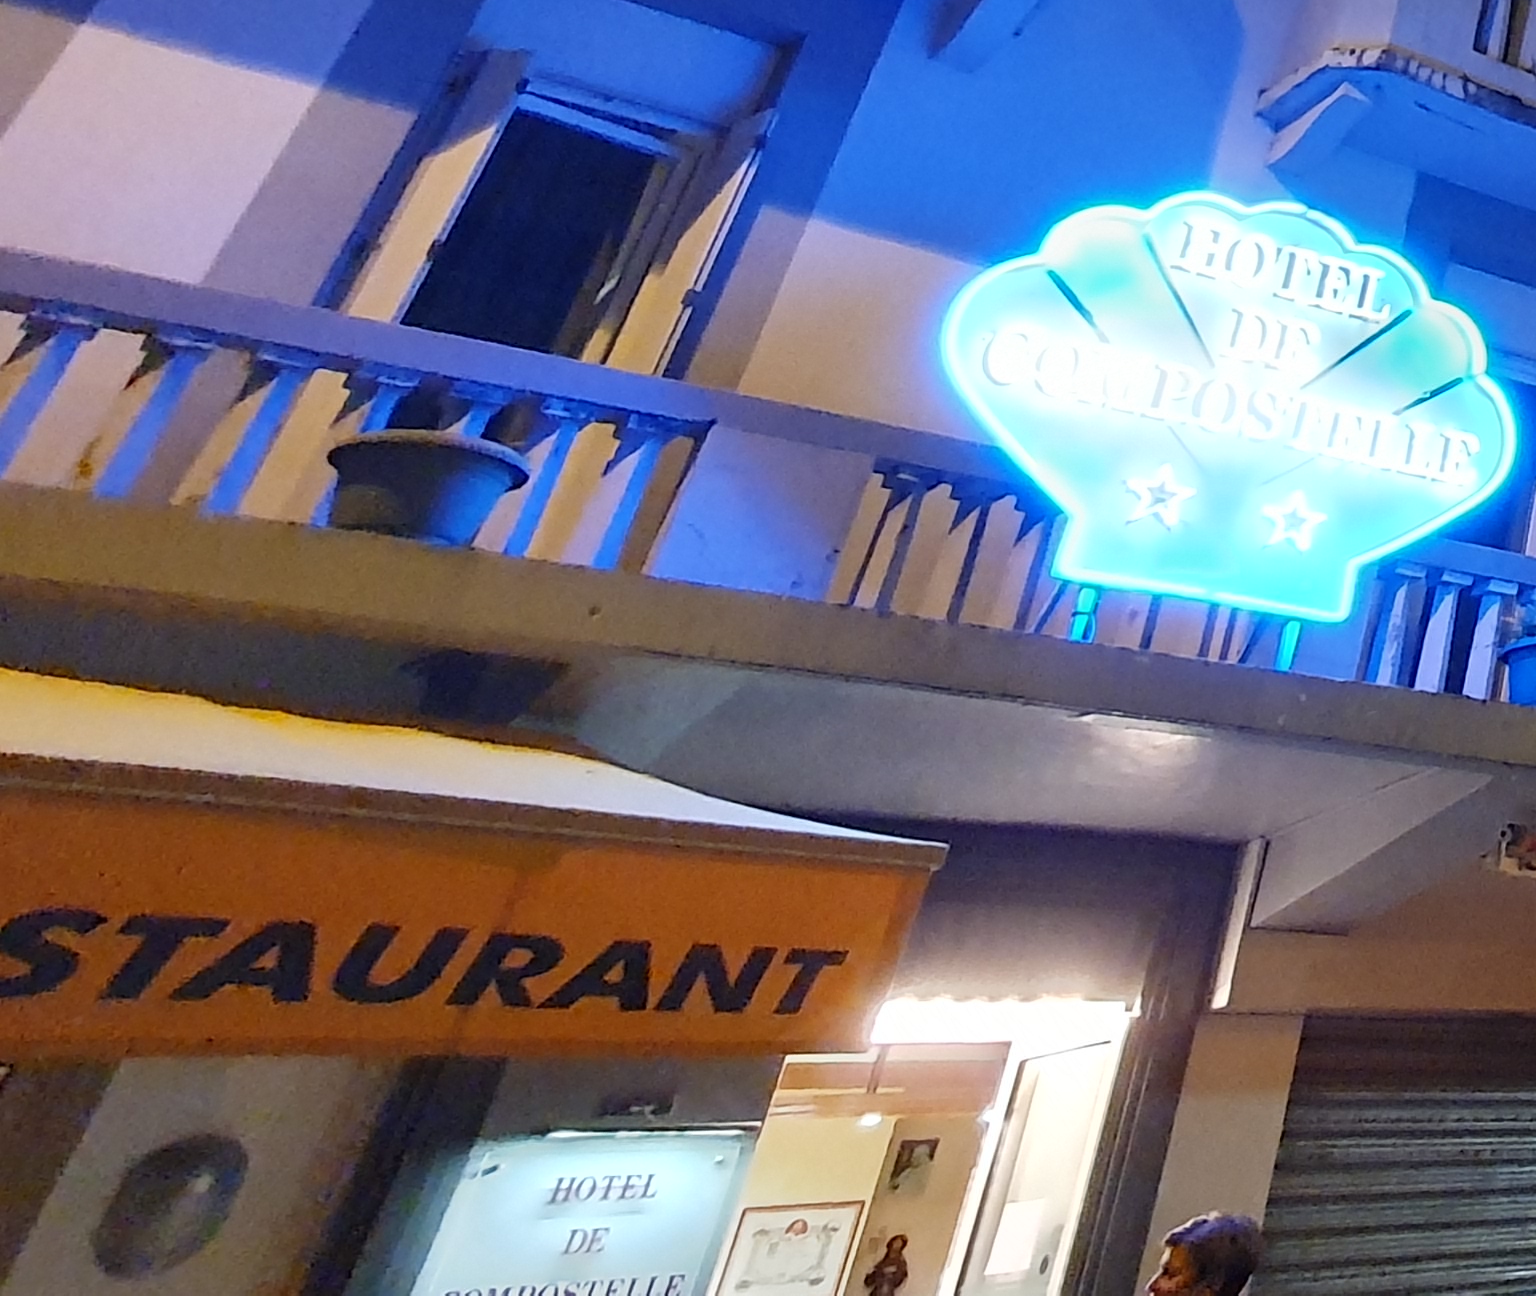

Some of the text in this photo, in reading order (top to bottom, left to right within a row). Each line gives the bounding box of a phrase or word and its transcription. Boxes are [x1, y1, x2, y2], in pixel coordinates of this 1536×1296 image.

[1169, 218, 1393, 325] HOTEL
[1216, 306, 1321, 372] DE
[980, 323, 1482, 488] COMPOSTELLE
[0, 906, 849, 1015] STAURANT
[545, 1173, 659, 1205] HOTEL
[561, 1227, 612, 1256] DE
